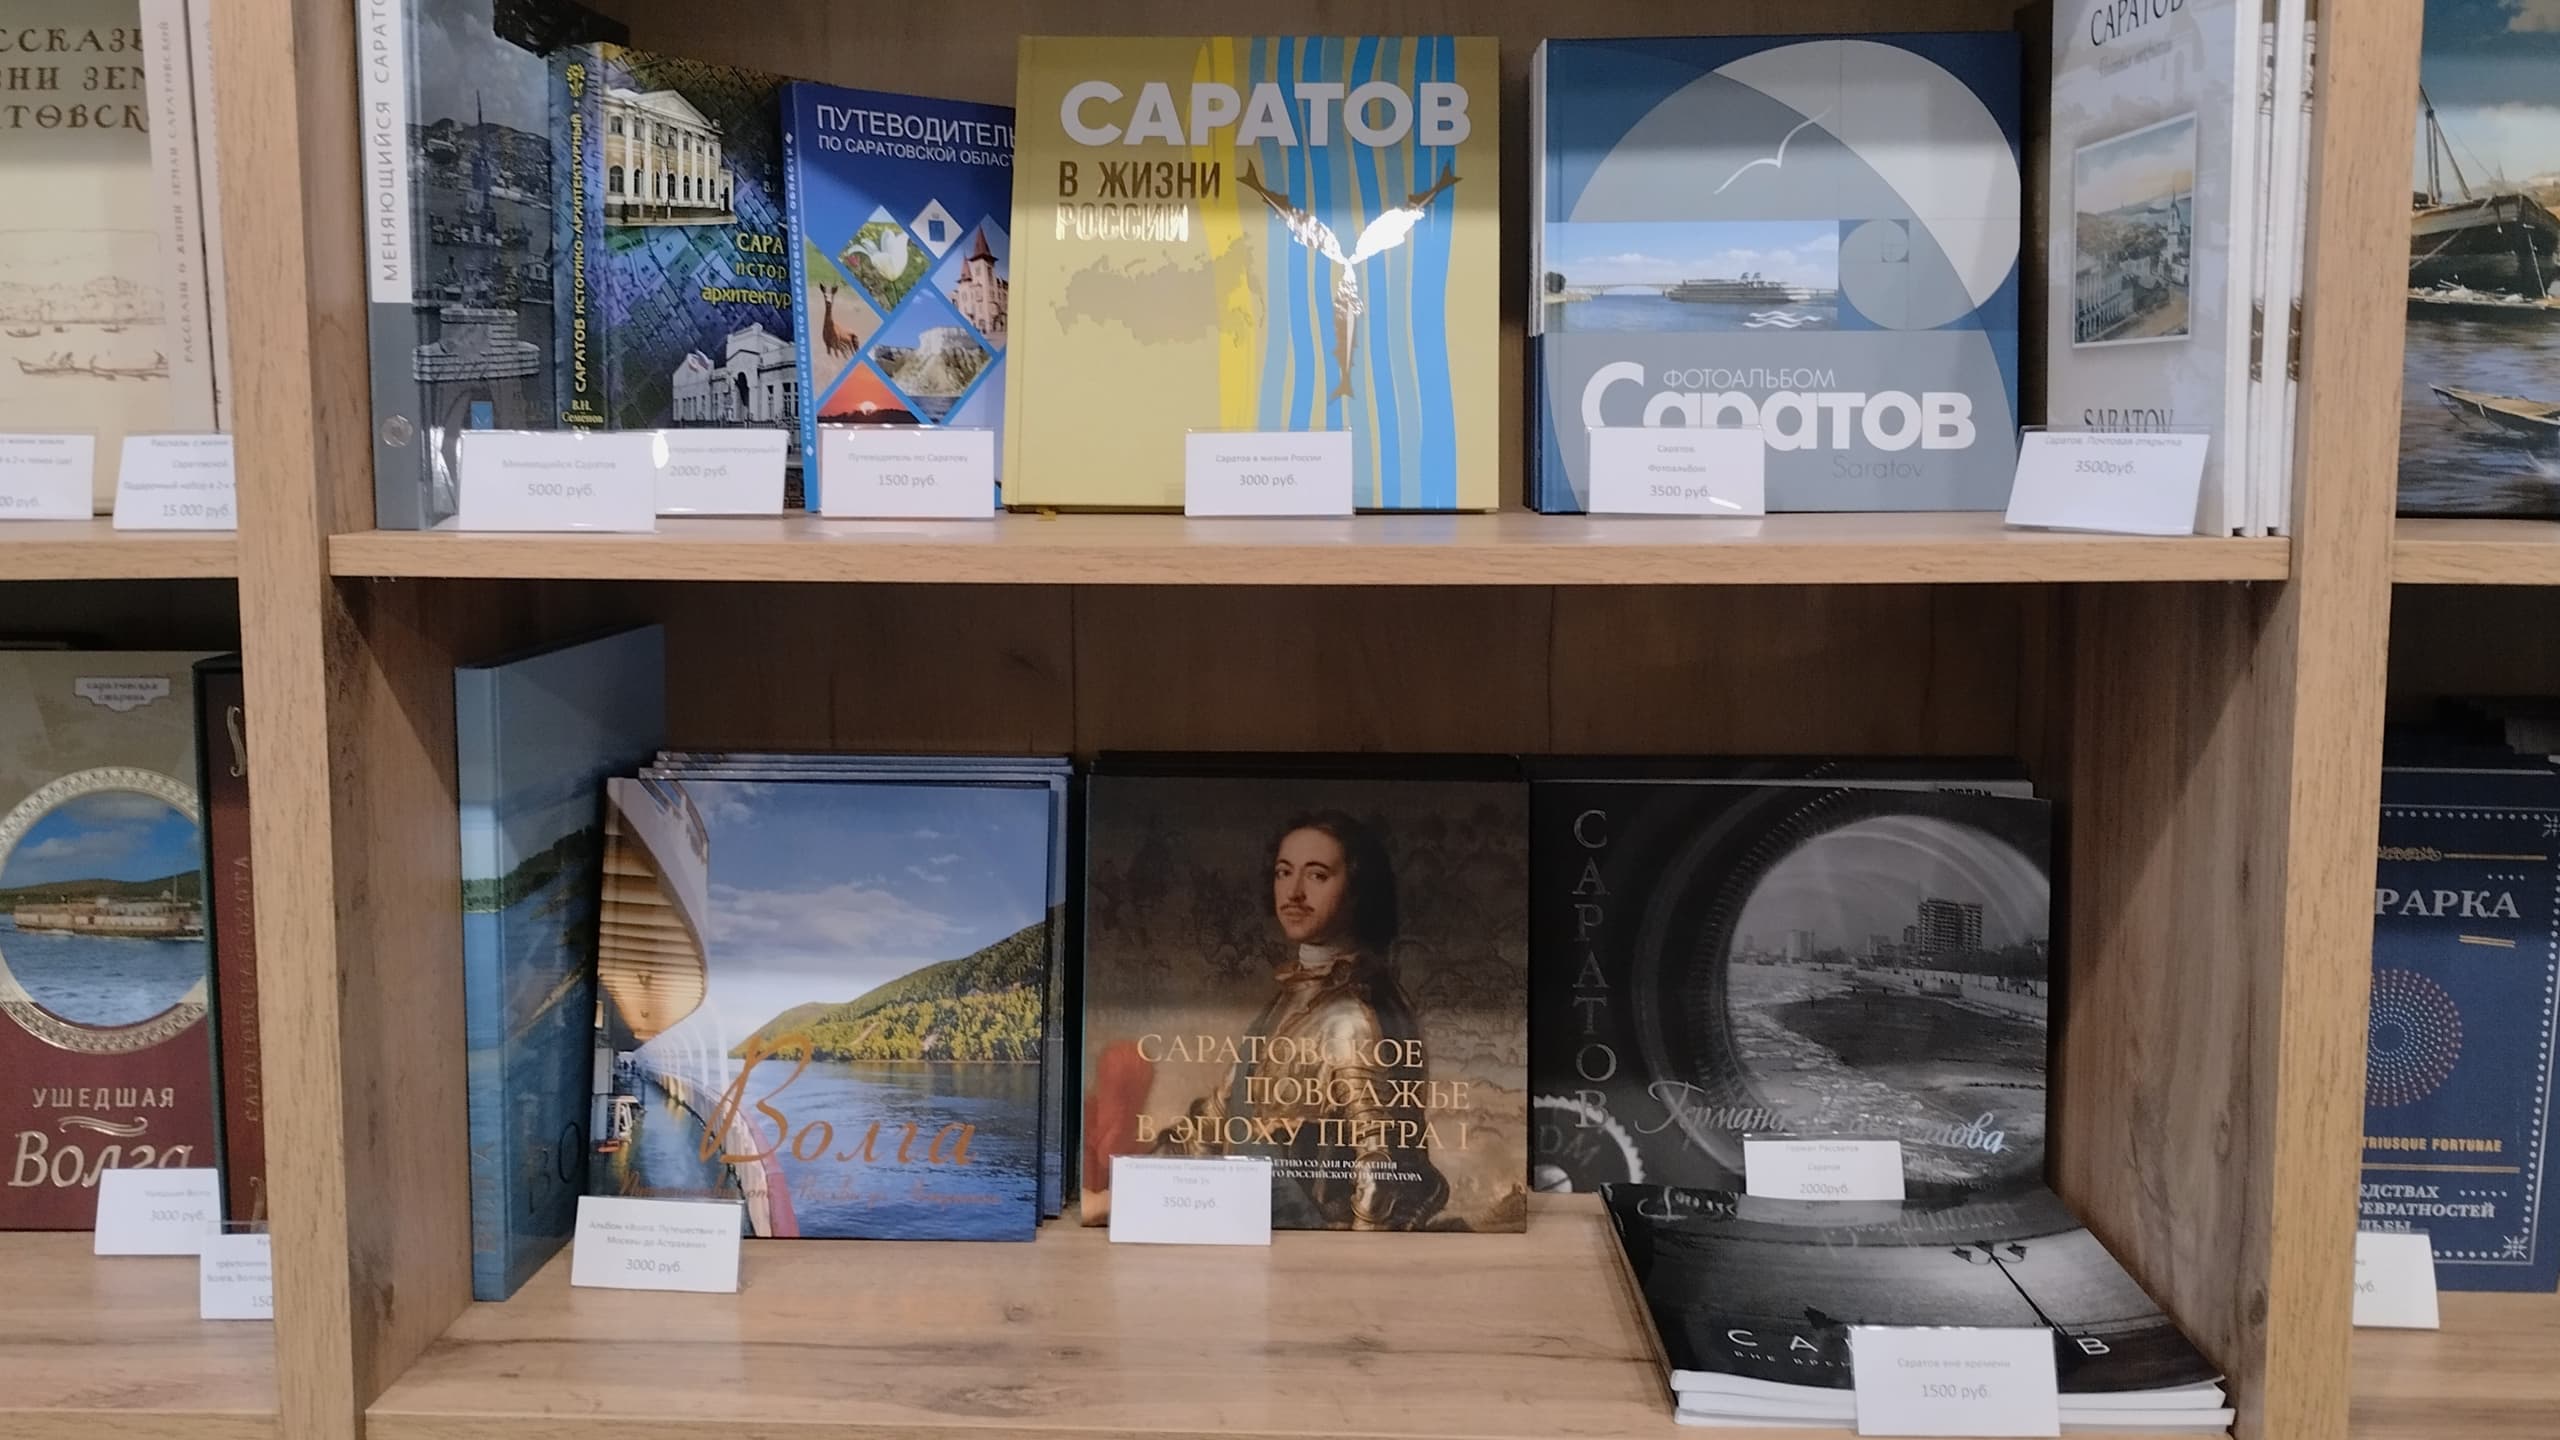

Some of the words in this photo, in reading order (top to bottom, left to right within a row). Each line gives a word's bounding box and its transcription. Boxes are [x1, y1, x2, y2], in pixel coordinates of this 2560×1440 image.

[2090, 0, 2184, 46] САРАТО
[0, 66, 60, 90] НИ
[817, 104, 1016, 148] ПУТЕВОДИТЕЛЬ
[1060, 81, 1471, 147] САРАТОВ
[818, 134, 841, 152] ПО
[845, 138, 957, 163] САРАТОВСКОЙ
[373, 102, 398, 281] МЕНЯЮЩИЙСЯ
[1059, 160, 1078, 198] В
[1098, 160, 1222, 199] ЖИЗНИ
[1056, 203, 1190, 242] РОССИИ
[736, 232, 785, 255] САРА
[573, 319, 587, 393] САРАТОВ
[1663, 367, 1836, 390] ФОТОАЛЬБОМ
[669, 464, 700, 477] 2000
[879, 473, 909, 486] 1500
[1831, 456, 1926, 479] Saratov
[527, 483, 562, 497] 5000
[566, 482, 597, 501] руб.
[1239, 474, 1269, 486] 3000
[1649, 484, 1682, 497] 3500
[162, 503, 177, 517] 15
[180, 503, 203, 517] 000
[2375, 888, 2521, 919] РАРКА
[1572, 809, 1618, 1130] САРАТОВ
[1137, 1033, 1424, 1068] САРАТОВСКОЕ
[32, 1087, 176, 1111] УШЕДШАЯ
[700, 1031, 978, 1165] Волга
[1244, 1076, 1471, 1110] ПОВОЛЖЬЕ
[1136, 1114, 1156, 1143] В
[1169, 1115, 1306, 1147] ЭПОХУ
[1317, 1118, 1445, 1150] ПЕТРА
[2432, 1137, 2502, 1152] FORTUNAE
[8, 1131, 194, 1188] Волга
[1304, 1159, 1318, 1167] СО
[1320, 1159, 1341, 1169] ДНЯ
[1286, 1168, 1357, 1179] РОССИЙСКОГО
[1162, 1196, 1192, 1209] 3500
[151, 1209, 180, 1221] 3000
[625, 1258, 656, 1272] 3000
[1921, 1383, 1957, 1398] 1500
